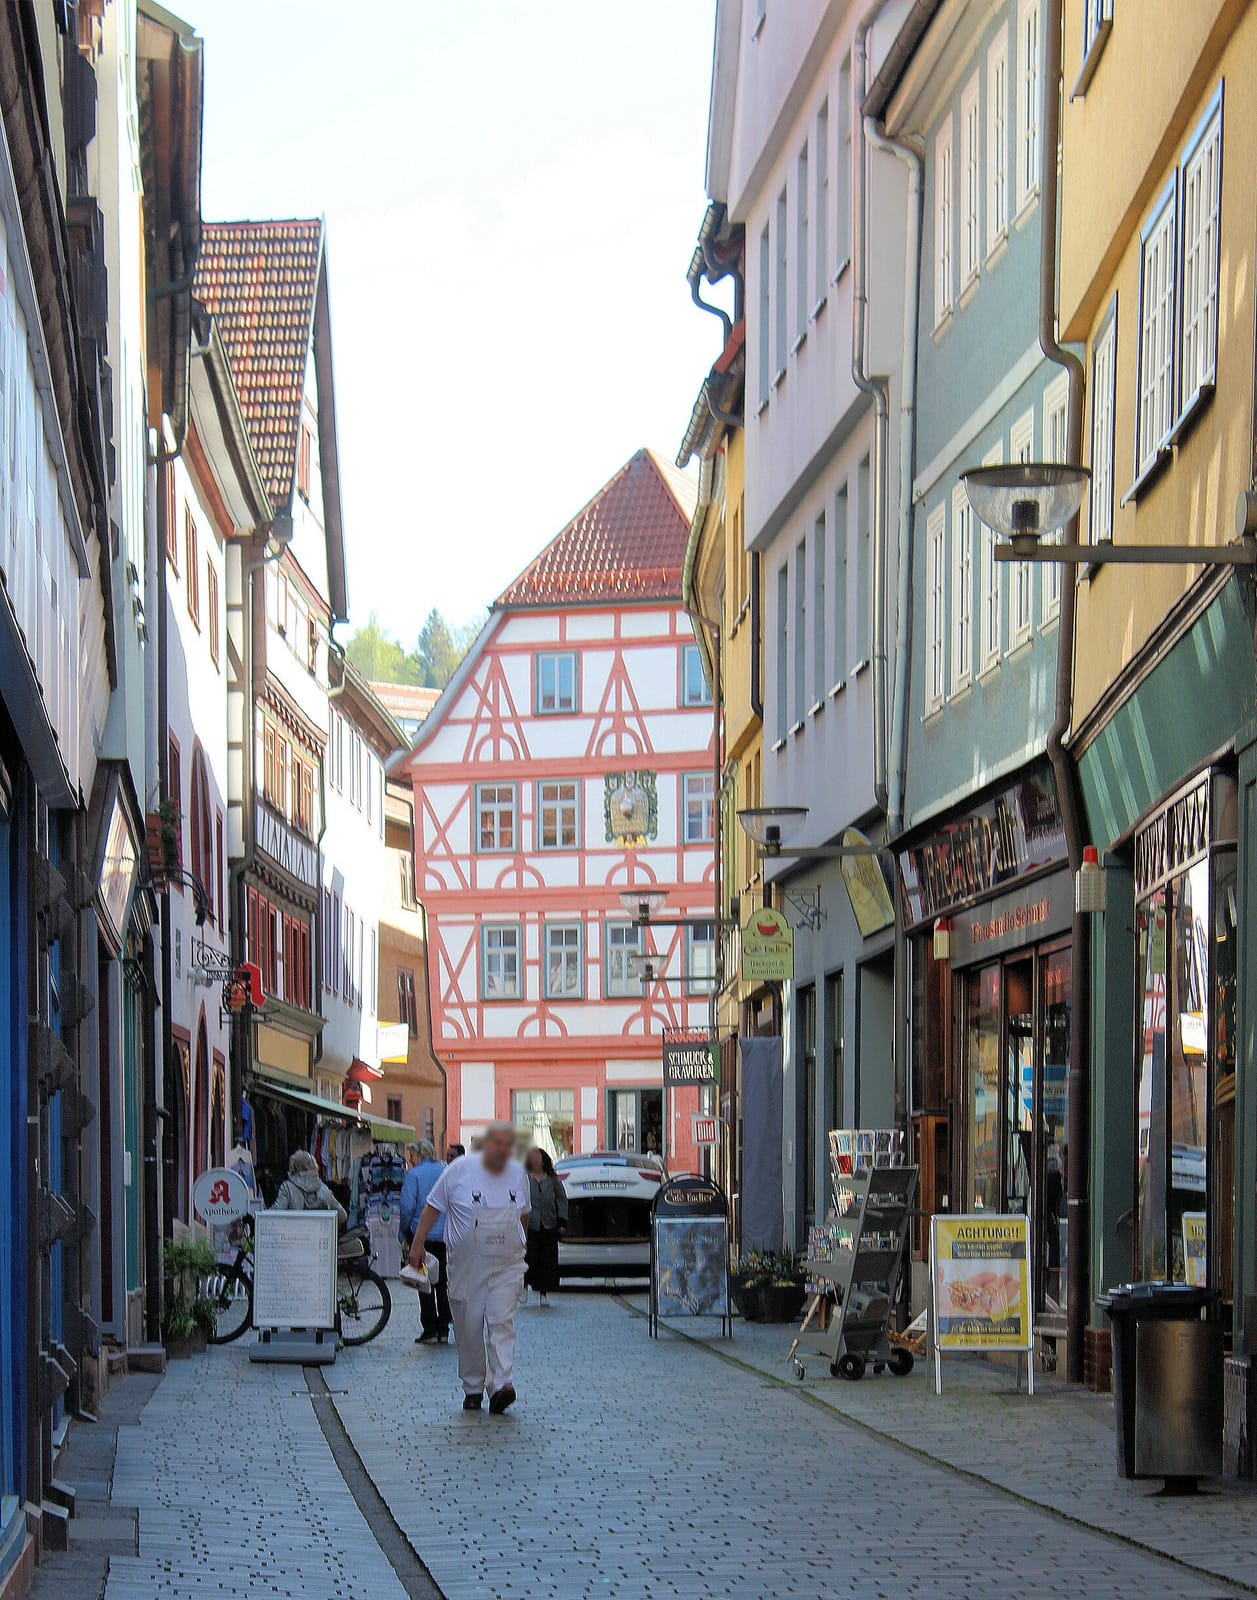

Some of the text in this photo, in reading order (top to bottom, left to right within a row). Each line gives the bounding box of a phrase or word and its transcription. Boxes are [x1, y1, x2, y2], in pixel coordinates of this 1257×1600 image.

[668, 1050, 714, 1065] SCHMUCK &
[668, 1064, 714, 1080] GRAVUREN
[203, 1207, 240, 1217] Apotheke
